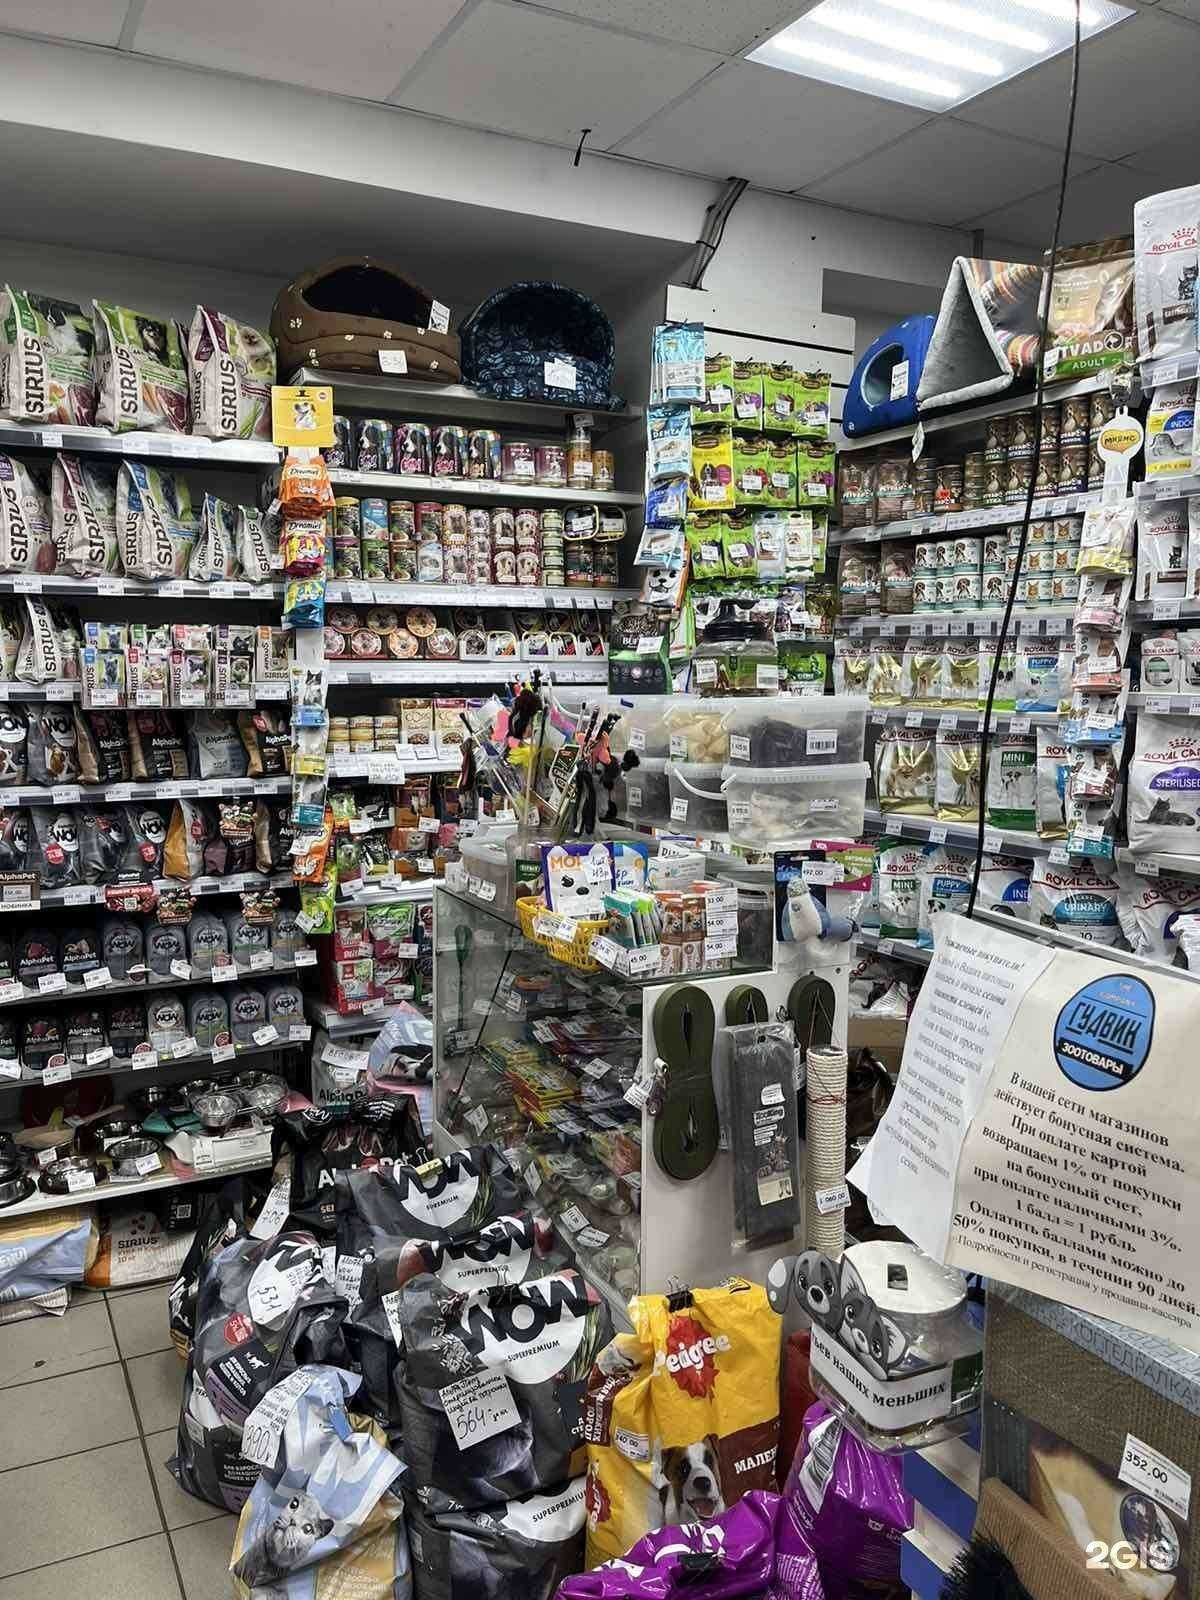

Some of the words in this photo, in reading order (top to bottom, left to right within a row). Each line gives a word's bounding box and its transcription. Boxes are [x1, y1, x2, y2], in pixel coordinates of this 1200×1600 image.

[1152, 241, 1180, 252] ROYAL
[23, 334, 45, 417] SIRIUS
[121, 343, 139, 415] SIRIUS
[1072, 358, 1105, 369] ADULT
[220, 358, 241, 434] SIRIUS
[10, 486, 29, 563] SIRIUS
[80, 490, 106, 563] SIRIUS
[124, 511, 140, 568] SIRIUS
[210, 515, 224, 568] SIRIUS
[247, 521, 271, 572] SIRIUS
[40, 616, 57, 672] SIRIUS
[1003, 752, 1025, 762] MINI
[1144, 752, 1178, 760] ROYAL
[887, 864, 911, 872] ROYAL
[936, 880, 960, 888] PUPPY
[1046, 873, 1082, 886] ROYAL
[1064, 902, 1107, 912] URINARY
[20, 955, 55, 966] AlphaPet
[64, 952, 97, 962] AlphaPet
[68, 1027, 100, 1035] AlphaPet
[155, 1013, 179, 1022] WOW
[1068, 1002, 1142, 1049] ГУДВИК
[1062, 1042, 1124, 1075] ЗООТОВАРЫ
[993, 1088, 1046, 1117] действует
[1048, 1110, 1112, 1147] бонусная
[1116, 1139, 1185, 1173] система.
[1010, 1071, 1019, 1085] В
[1020, 1079, 1056, 1102] нашей
[1057, 1095, 1085, 1116] сети
[1089, 1109, 1169, 1147] магазинов
[982, 1126, 1058, 1168] возвращаем
[1062, 1162, 1087, 1178] 1%
[1090, 1171, 1107, 1185] от
[1112, 1179, 1182, 1212] покупки
[1011, 1114, 1036, 1137] При
[1038, 1130, 1087, 1157] оплате
[1090, 1150, 1147, 1178] картой
[974, 1165, 999, 1187] при
[1001, 1177, 1050, 1202] оплате
[1053, 1194, 1147, 1239] наличными
[1149, 1228, 1183, 1253] 3%.
[1006, 1159, 1023, 1175] на
[1026, 1165, 1099, 1201] бонусный
[1103, 1193, 1144, 1218] счет.
[118, 1237, 159, 1249] SIRIUS
[969, 1199, 1039, 1236] Оплатить
[1042, 1225, 1108, 1262] баллами
[1110, 1255, 1164, 1284] можно
[1166, 1278, 1185, 1293] до
[1015, 1199, 1022, 1211] 1
[1026, 1202, 1061, 1225] балл
[1063, 1219, 1075, 1229] =
[1079, 1222, 1086, 1234] 1
[1090, 1228, 1137, 1253] рубль
[117, 1256, 127, 1264] 10
[952, 1214, 986, 1235] 50%
[989, 1226, 1055, 1261] покупки,
[1057, 1252, 1067, 1264] в
[1070, 1255, 1133, 1291] течении
[1136, 1281, 1155, 1298] 90
[1158, 1292, 1200, 1318] дней.
[460, 1274, 590, 1356] WOW
[508, 1339, 560, 1362] SUPERPREMIUM
[1069, 1317, 1193, 1399] КОГТЕДРАЛКА
[833, 1355, 869, 1399] наших
[872, 1382, 946, 1408] меньших
[456, 1407, 486, 1440] 564
[1124, 1450, 1168, 1484] 352.00
